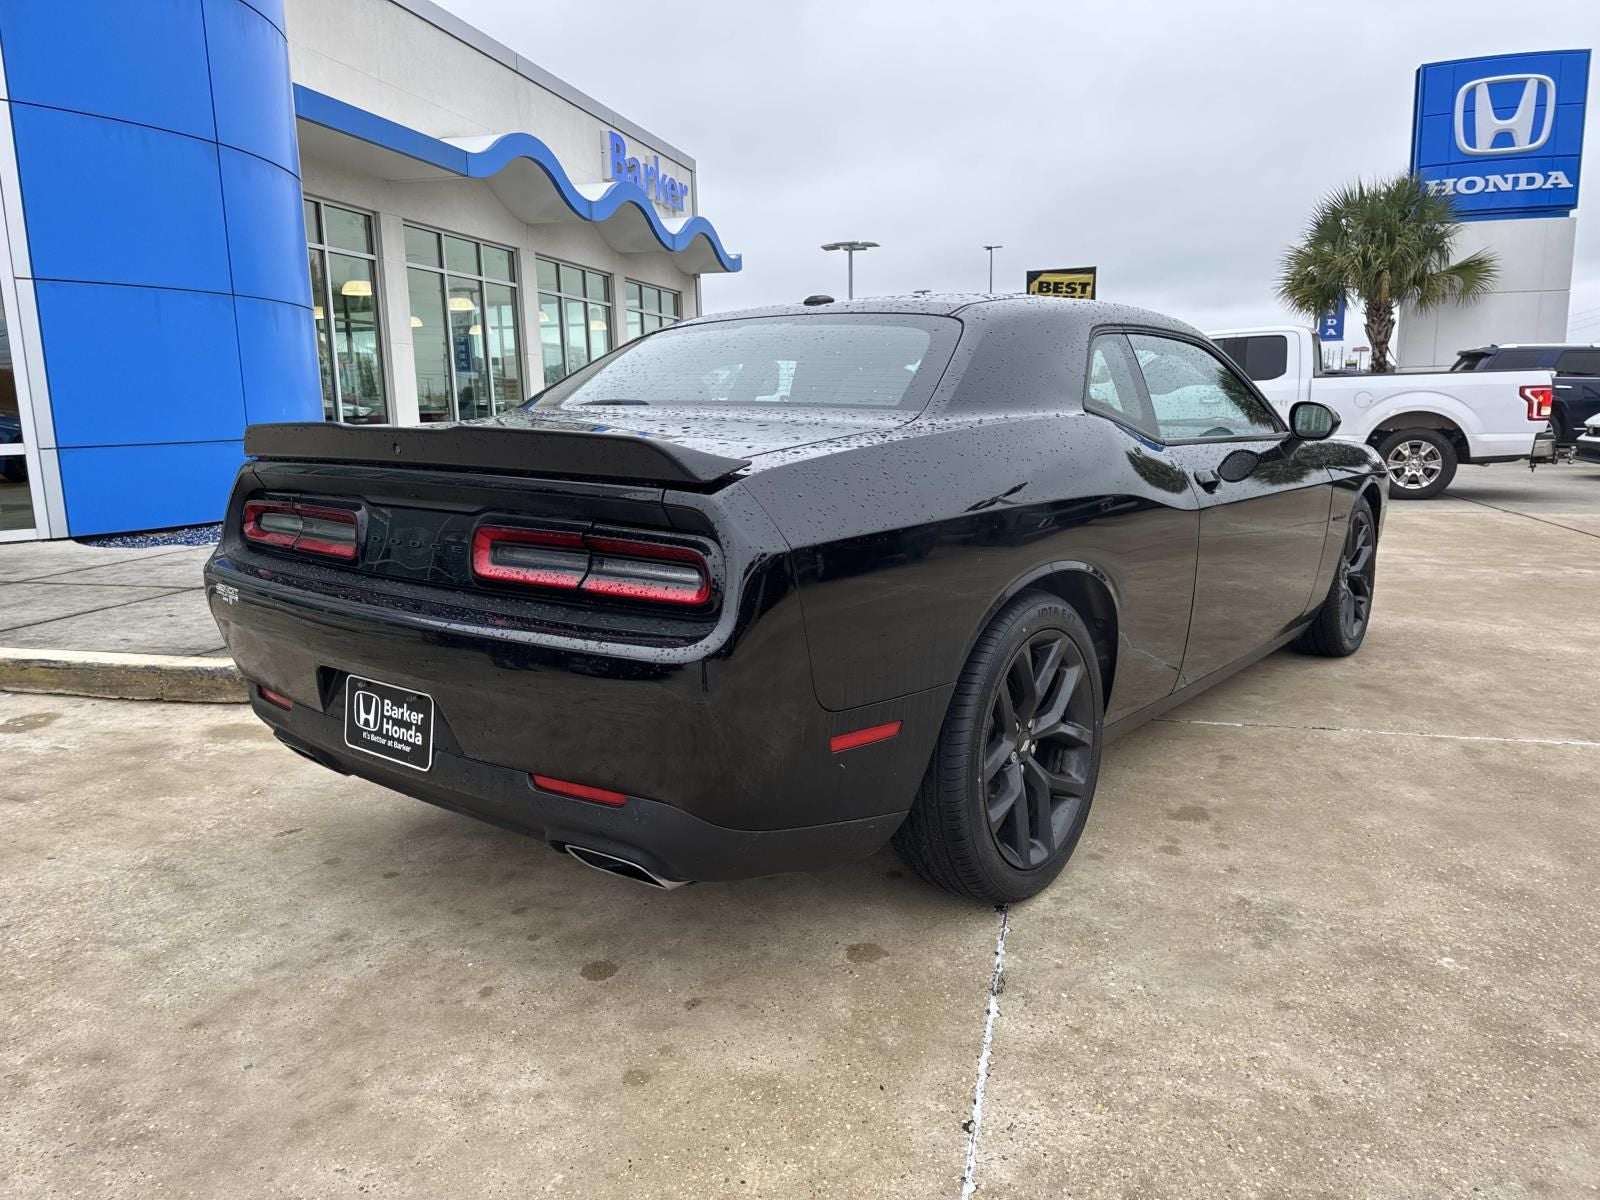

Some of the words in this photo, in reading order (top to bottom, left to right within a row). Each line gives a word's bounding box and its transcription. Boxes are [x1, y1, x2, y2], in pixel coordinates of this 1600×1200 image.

[607, 131, 689, 212] Barker
[1425, 171, 1573, 197] HONDA
[1037, 281, 1091, 295] BEST
[383, 699, 424, 725] Barker
[382, 718, 422, 745] Honda
[393, 741, 412, 752] Barker
